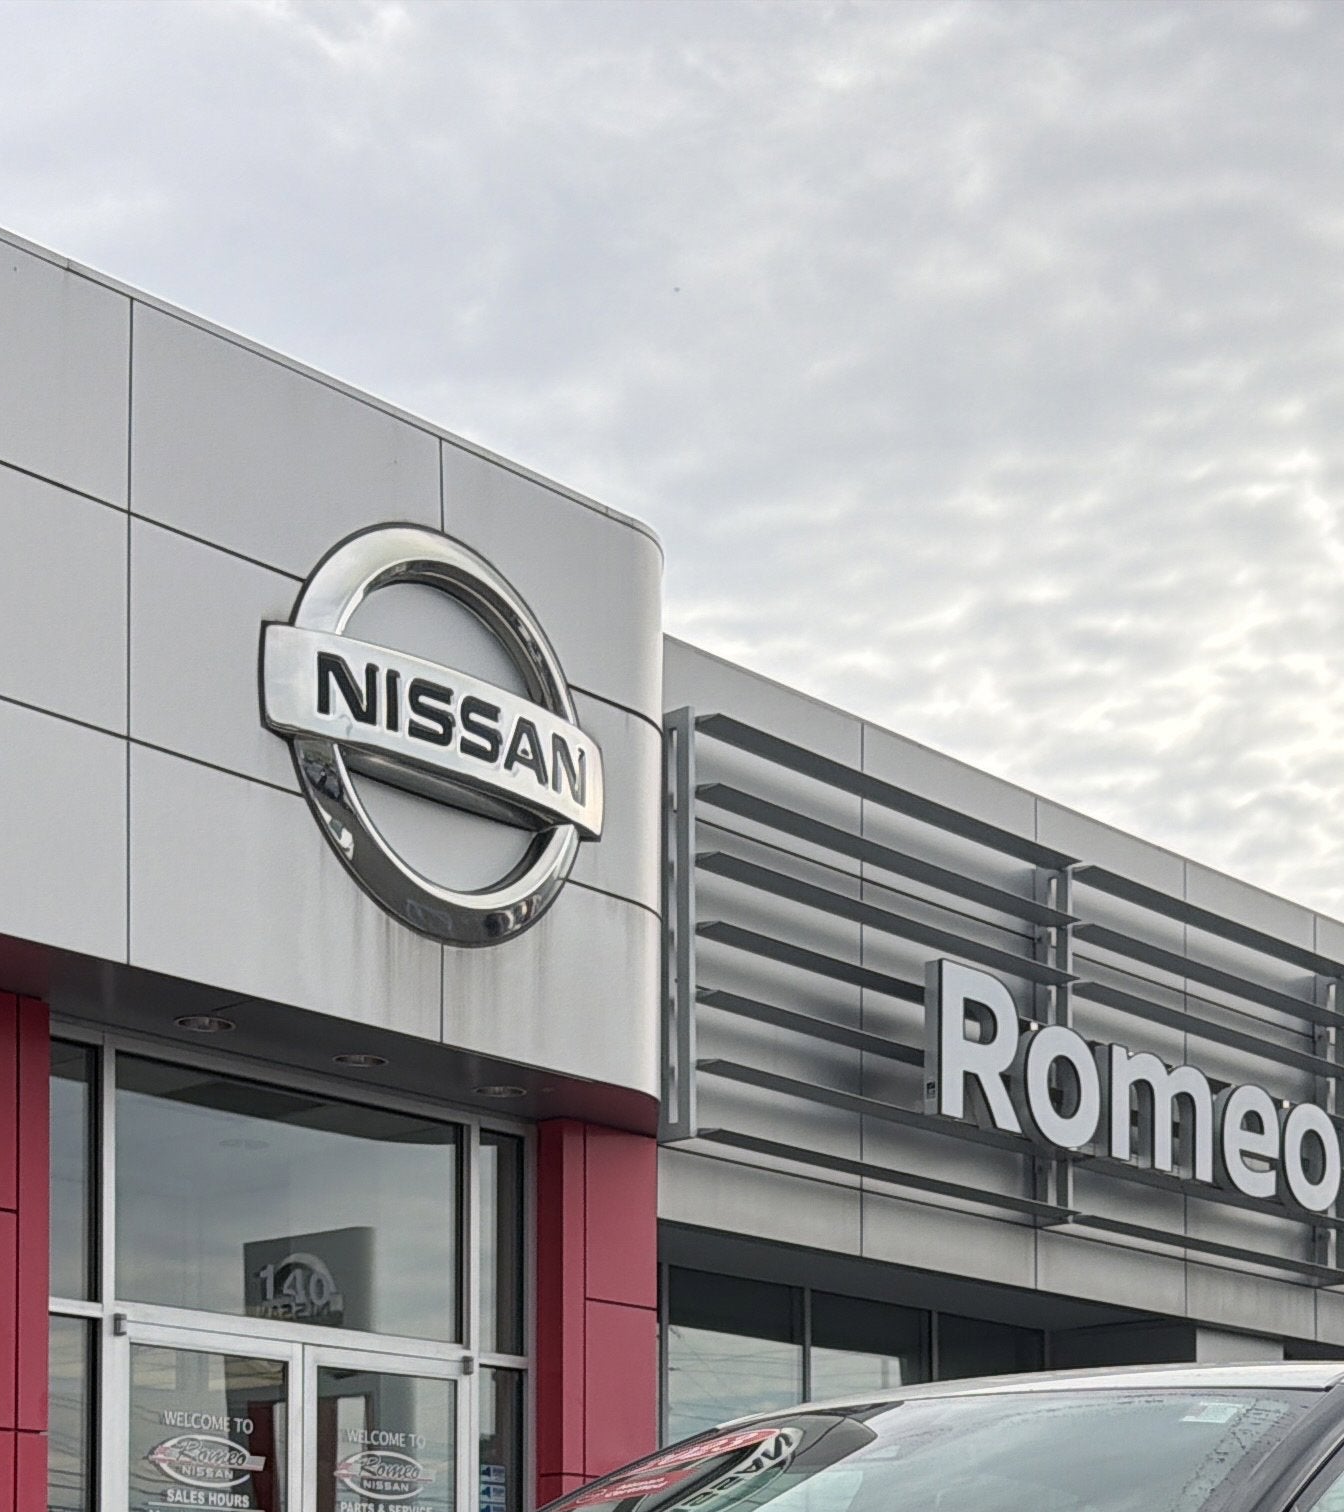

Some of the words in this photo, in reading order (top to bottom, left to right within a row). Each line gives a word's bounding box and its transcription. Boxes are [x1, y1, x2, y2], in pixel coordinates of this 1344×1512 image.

[316, 650, 587, 808] NISSAN
[936, 957, 1342, 1213] Romeo
[259, 1263, 331, 1306] 140
[164, 1410, 231, 1432] WELCOME
[233, 1417, 254, 1434] TO
[346, 1429, 406, 1447] WELCOME
[409, 1434, 426, 1449] TO
[176, 1440, 247, 1466] Romeo
[181, 1466, 234, 1480] NISSAN
[359, 1454, 420, 1479] Romeo
[166, 1489, 205, 1504] SALES
[208, 1492, 250, 1508] HOURS
[362, 1481, 409, 1492] NISSAN
